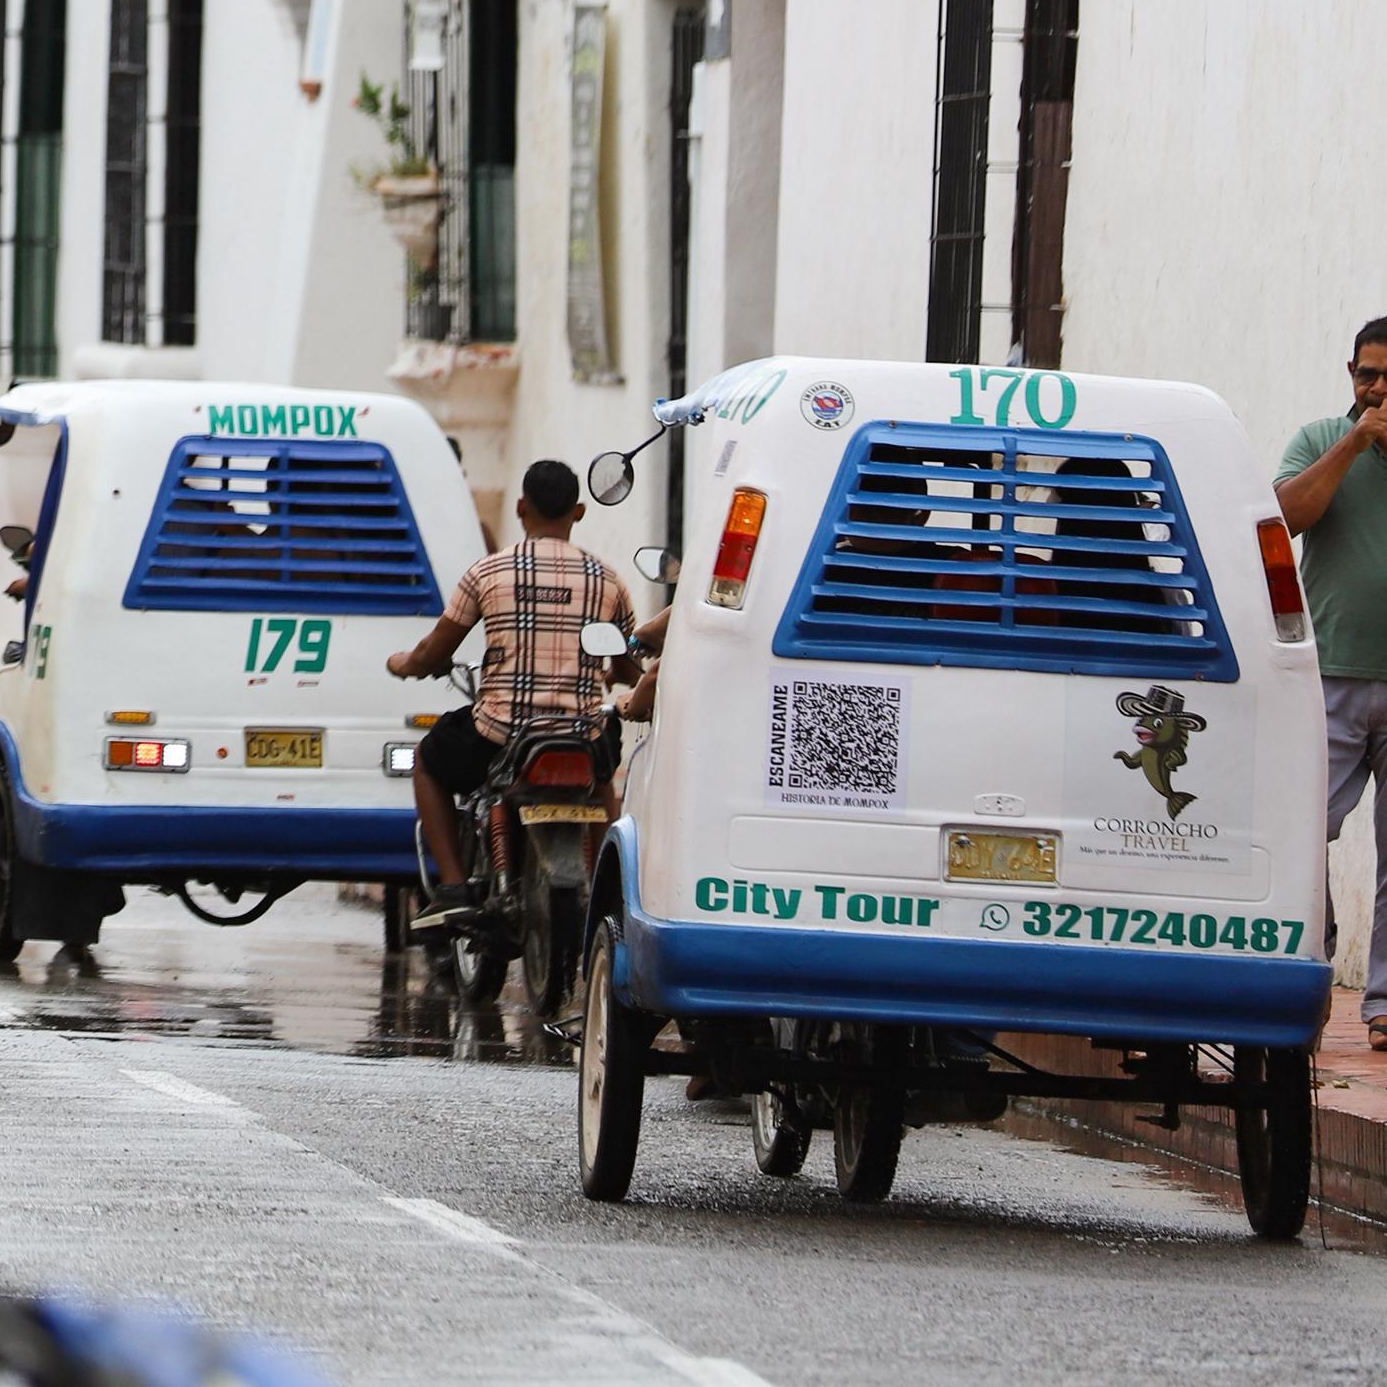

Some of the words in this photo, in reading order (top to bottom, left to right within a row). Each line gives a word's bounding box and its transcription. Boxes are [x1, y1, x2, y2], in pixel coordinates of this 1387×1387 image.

[208, 405, 357, 436] MOMPOX
[949, 367, 1077, 430] 170
[244, 618, 332, 673] 179
[769, 685, 788, 787] ESCANEAME
[1094, 817, 1218, 839] CORRONCHO
[1121, 833, 1191, 852] TRAVEL
[695, 877, 802, 920] City
[814, 885, 940, 927] Tour
[1022, 900, 1305, 954] 3217240487
